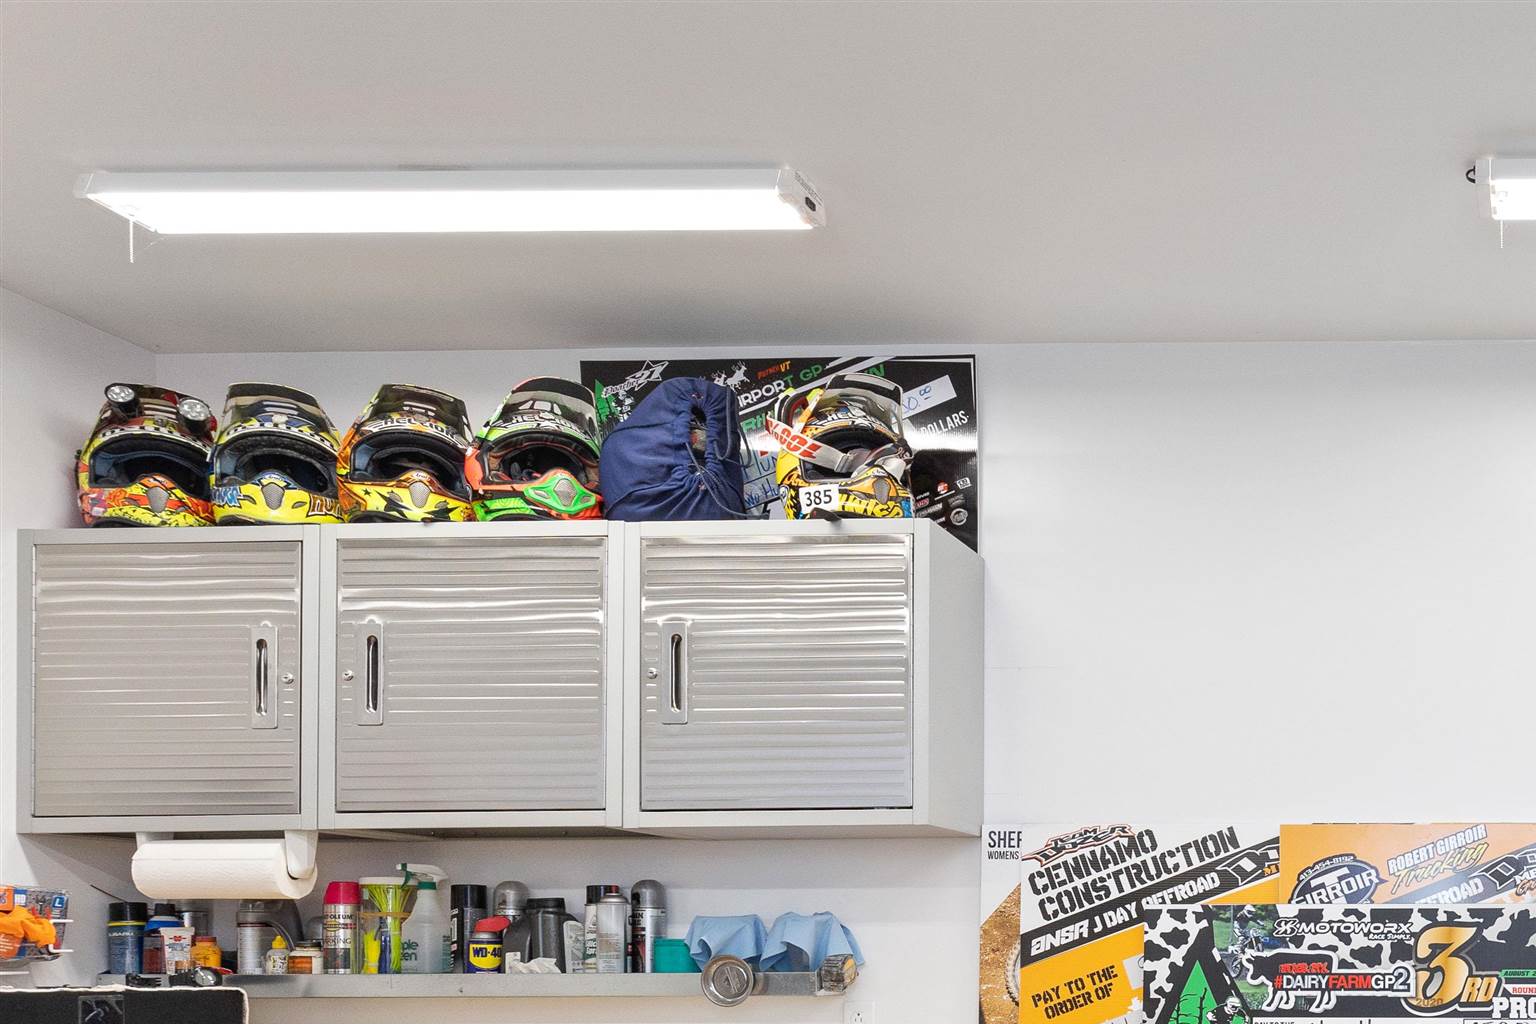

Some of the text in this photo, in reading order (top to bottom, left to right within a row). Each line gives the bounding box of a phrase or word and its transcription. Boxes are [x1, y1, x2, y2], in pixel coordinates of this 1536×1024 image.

[738, 375, 793, 408] IRPORT
[804, 489, 833, 507] 385
[1028, 829, 1158, 895] CENNAMO
[1388, 824, 1487, 874] ROBERT GIRROIR
[1038, 826, 1241, 921] CONSTRUCTION
[1093, 917, 1104, 933] J
[1103, 901, 1139, 929] DAY
[1298, 921, 1413, 934] MOTOWORX
[1032, 964, 1118, 1008] PAY TO THE
[1044, 982, 1114, 1020] ORDER OF
